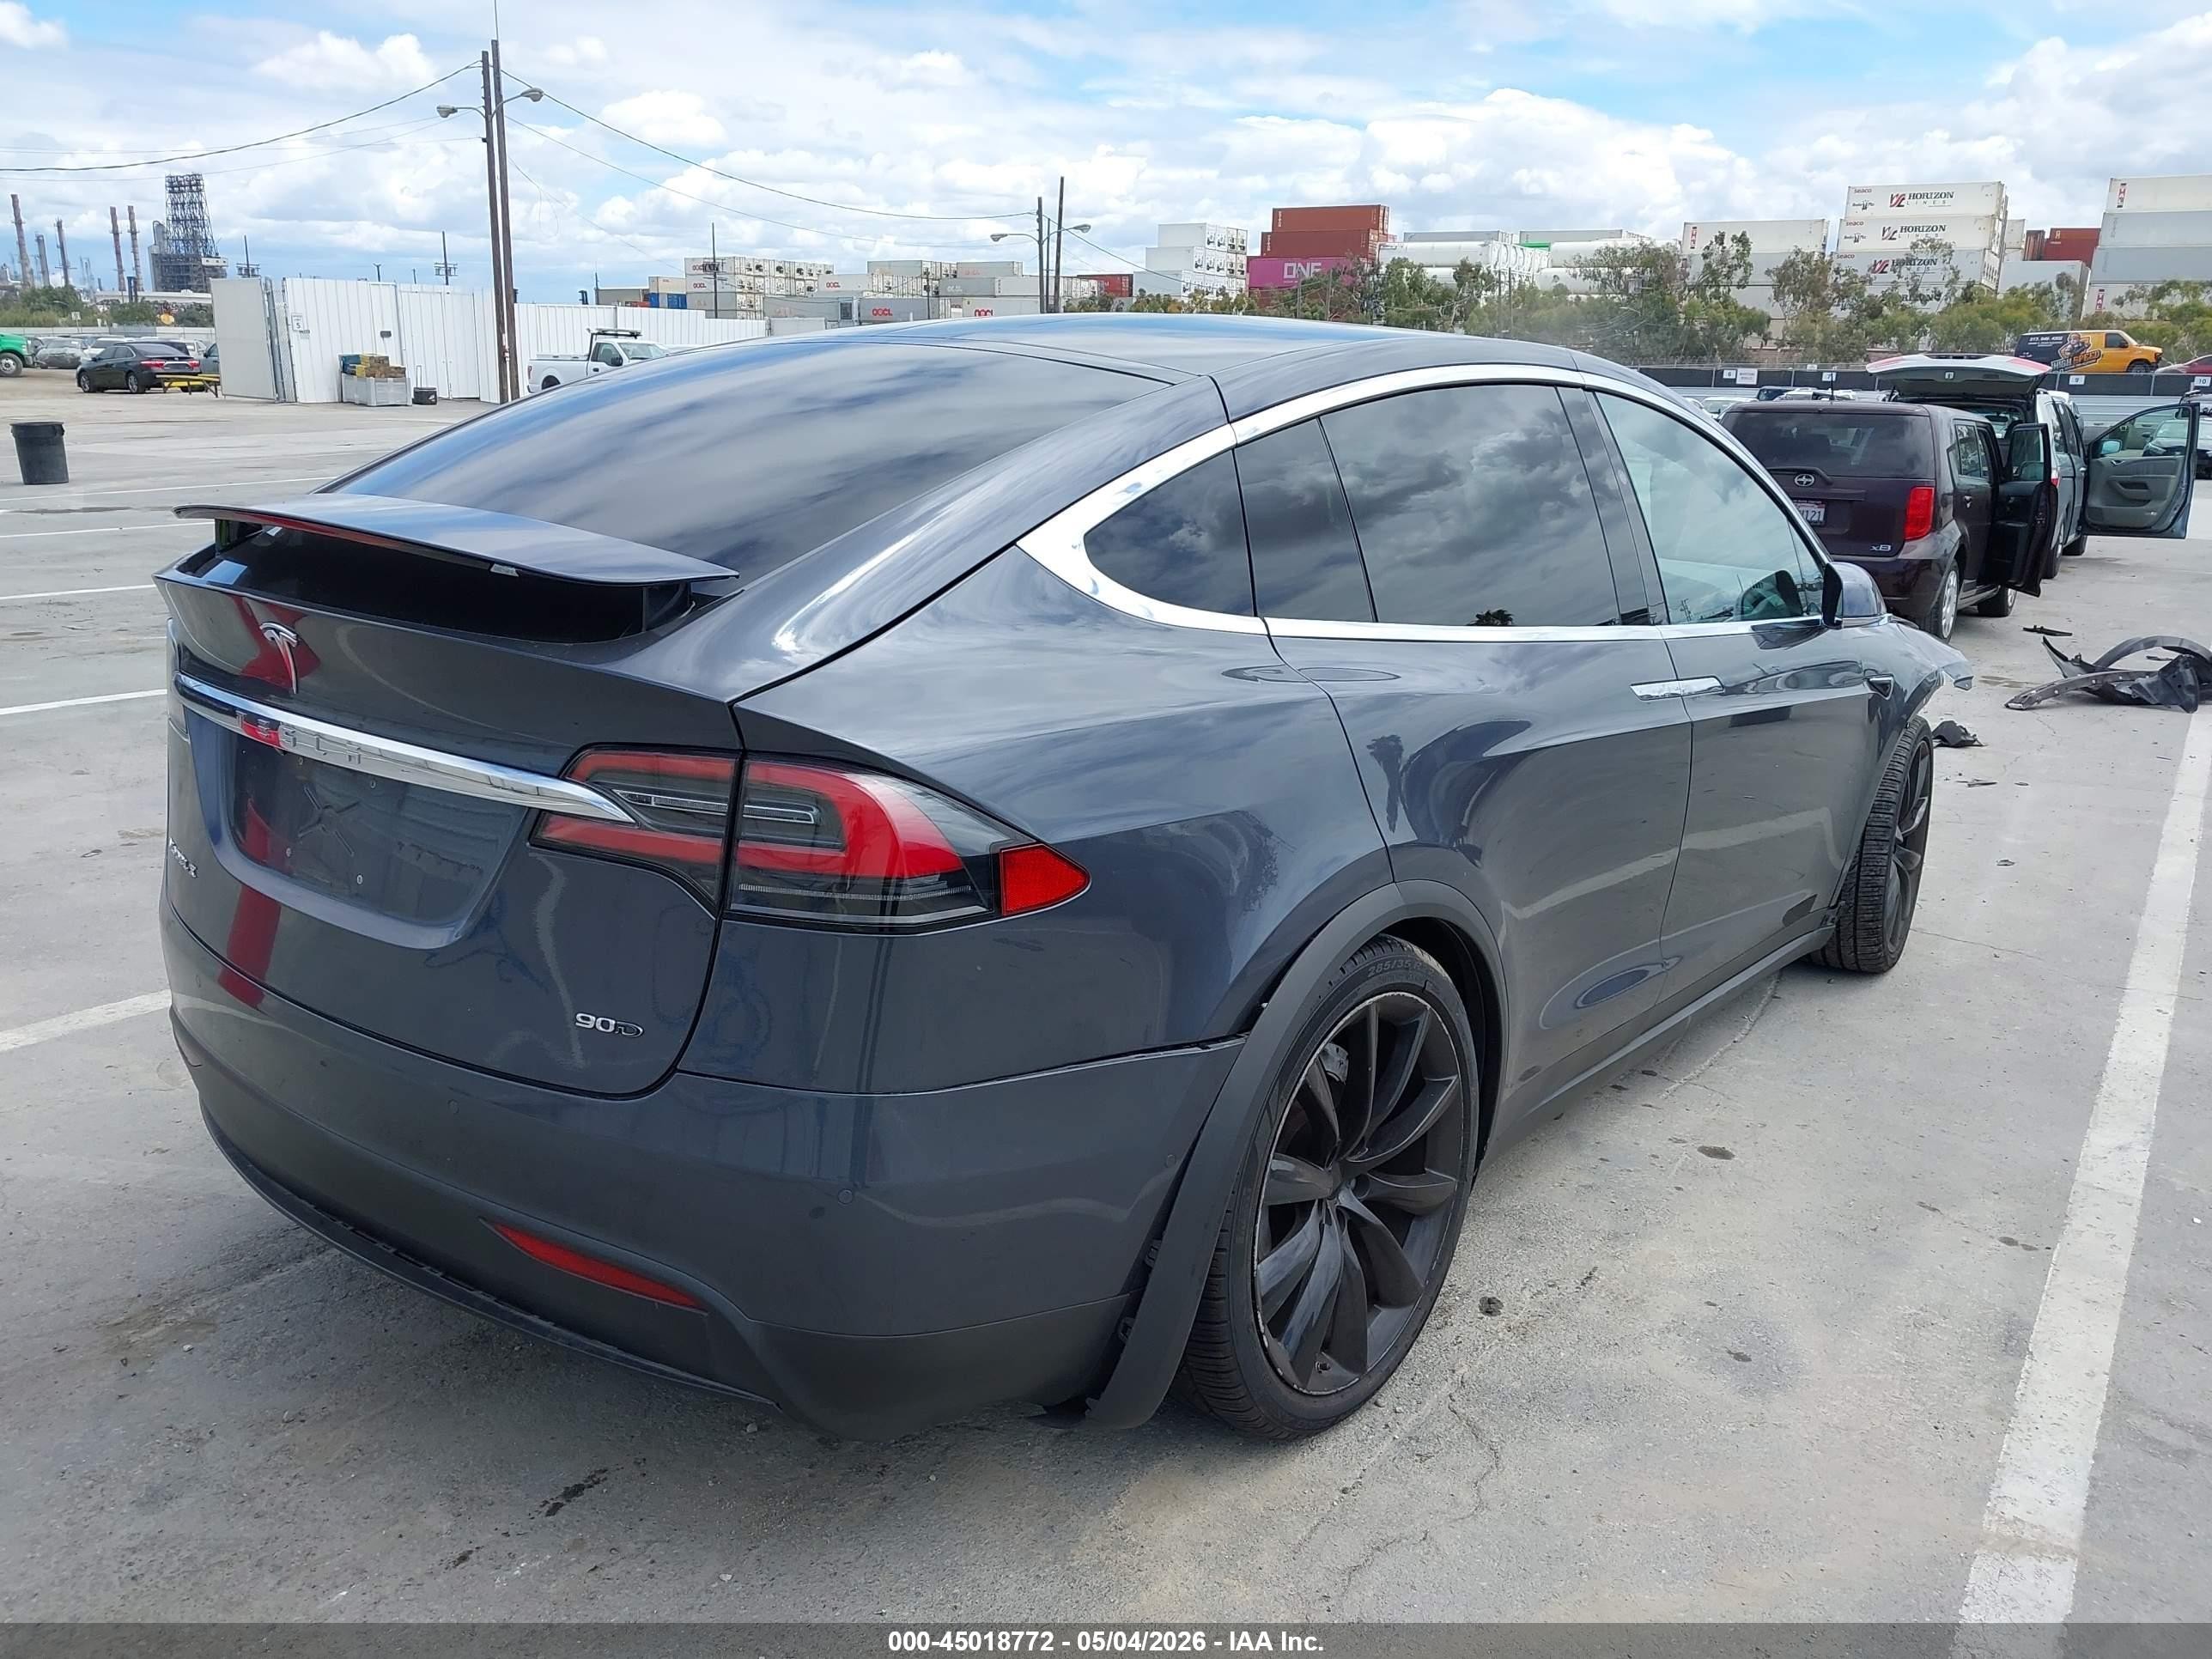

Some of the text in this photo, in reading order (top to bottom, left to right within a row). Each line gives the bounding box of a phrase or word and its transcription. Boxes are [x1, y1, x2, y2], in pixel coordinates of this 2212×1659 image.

[872, 307, 893, 317] OOCL
[235, 709, 362, 764] TESLA
[574, 1012, 644, 1037] 90D
